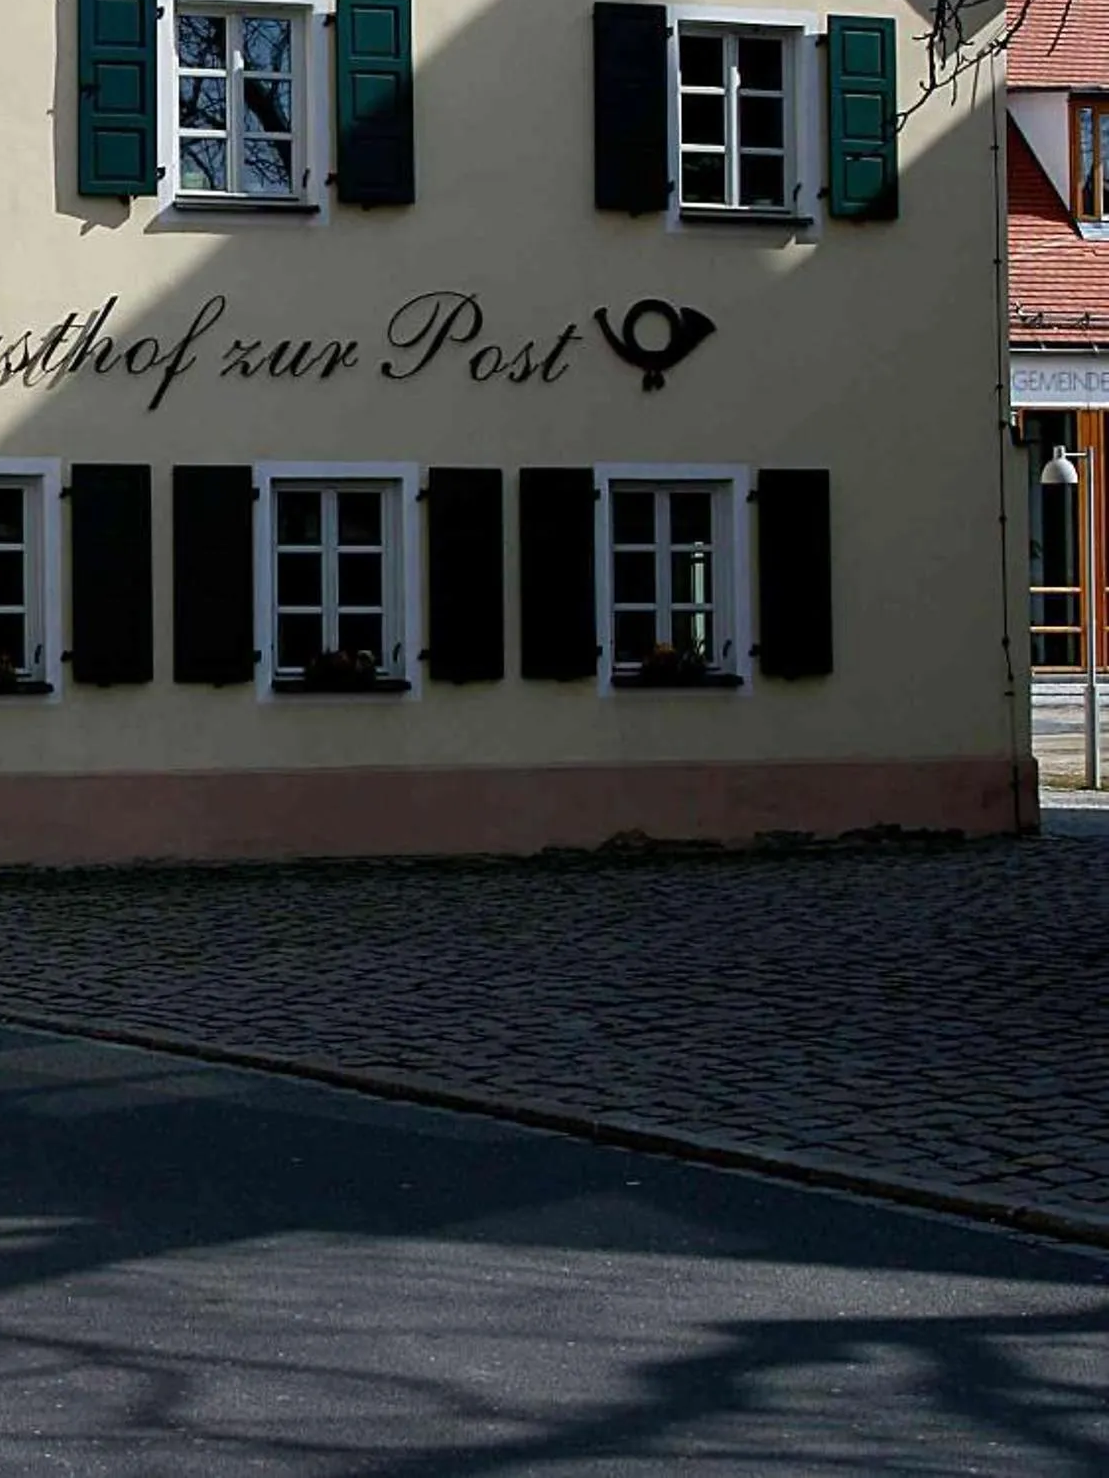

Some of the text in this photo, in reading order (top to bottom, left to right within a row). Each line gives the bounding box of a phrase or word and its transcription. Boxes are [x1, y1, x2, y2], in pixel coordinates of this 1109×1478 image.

[219, 339, 359, 379] zur
[381, 290, 583, 383] Post
[1012, 370, 1109, 392] GEMEINDE
